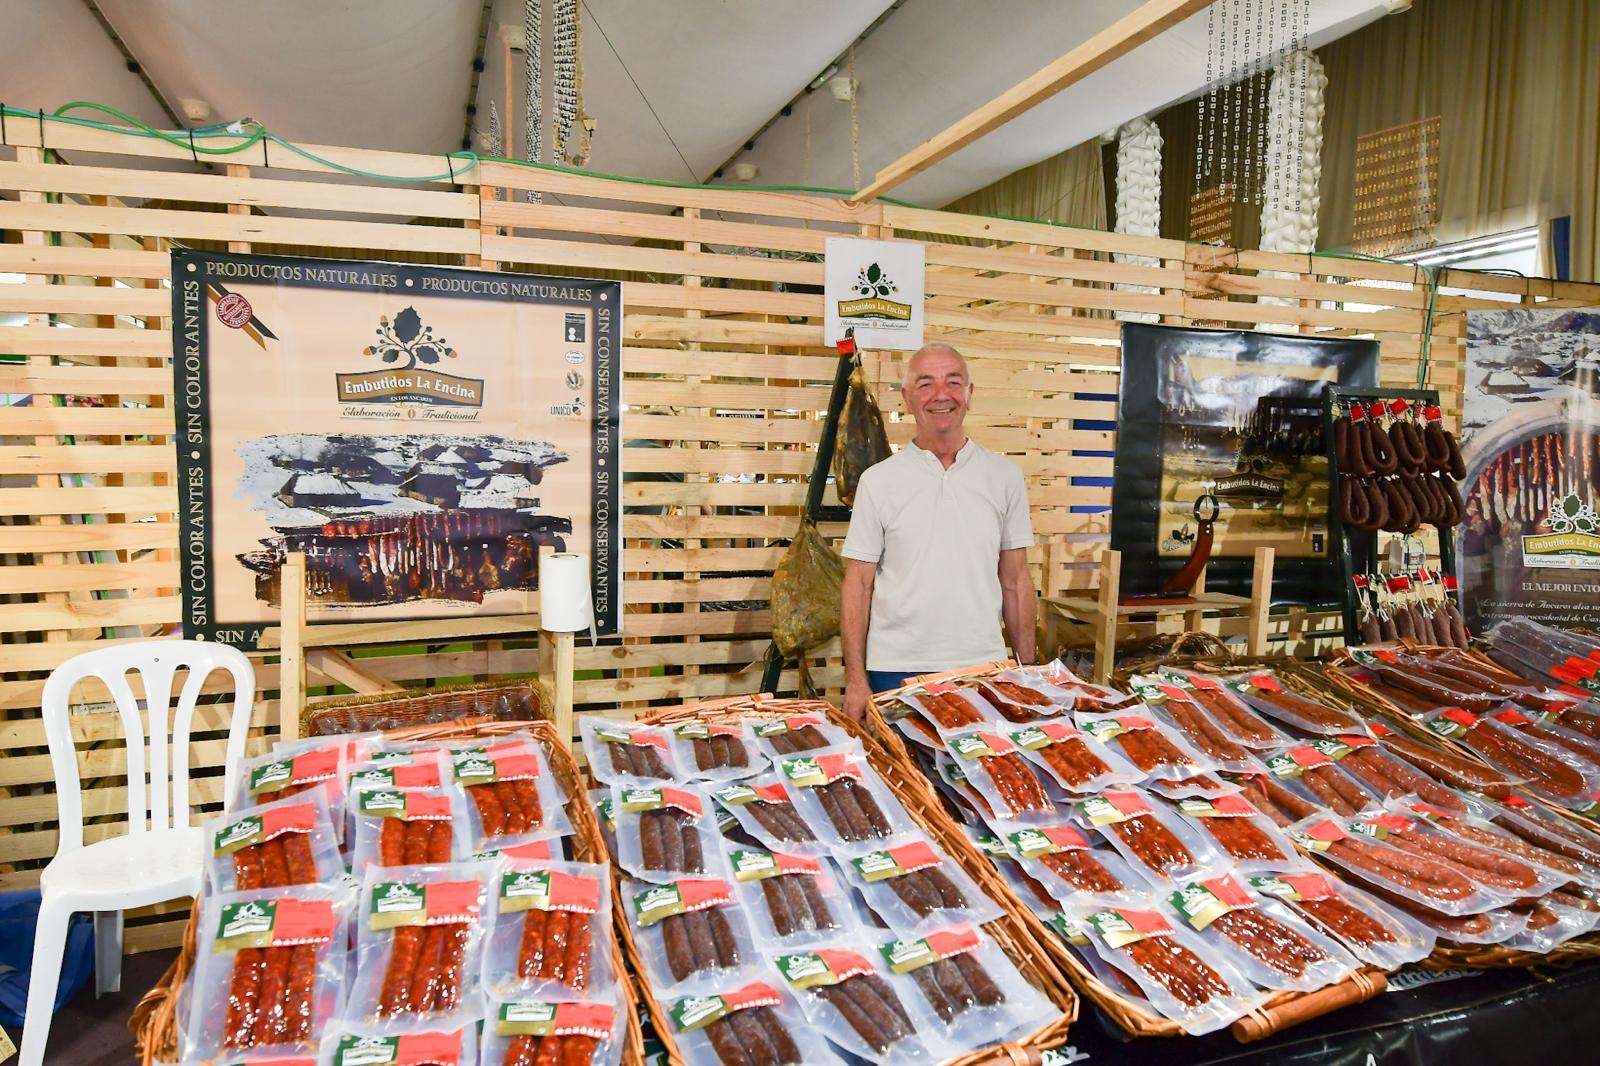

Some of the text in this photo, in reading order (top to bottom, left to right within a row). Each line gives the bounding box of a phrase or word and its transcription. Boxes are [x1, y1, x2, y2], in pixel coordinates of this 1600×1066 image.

[206, 261, 398, 288] PRODUCTOS NATURALES
[422, 276, 592, 302] PRODUCTOS NATURALES
[842, 303, 875, 312] Embutidos
[877, 302, 885, 310] La
[887, 305, 907, 315] Encina
[183, 280, 203, 444] SIN COLORANTES
[345, 375, 475, 398] Embutidos La Encina
[597, 308, 610, 454] SIN CONSERVANTES
[422, 409, 479, 420] Tradicional
[1217, 477, 1250, 490] Embutidos
[1251, 478, 1259, 487] La
[188, 467, 207, 626] SIN COLORANTES
[596, 472, 609, 614] SIN CONSERVANTES
[1529, 538, 1574, 550] Embutidos
[1576, 537, 1585, 546] La
[1522, 582, 1534, 591] EL
[1535, 583, 1572, 592] MEJOR
[215, 630, 245, 643] SIN
